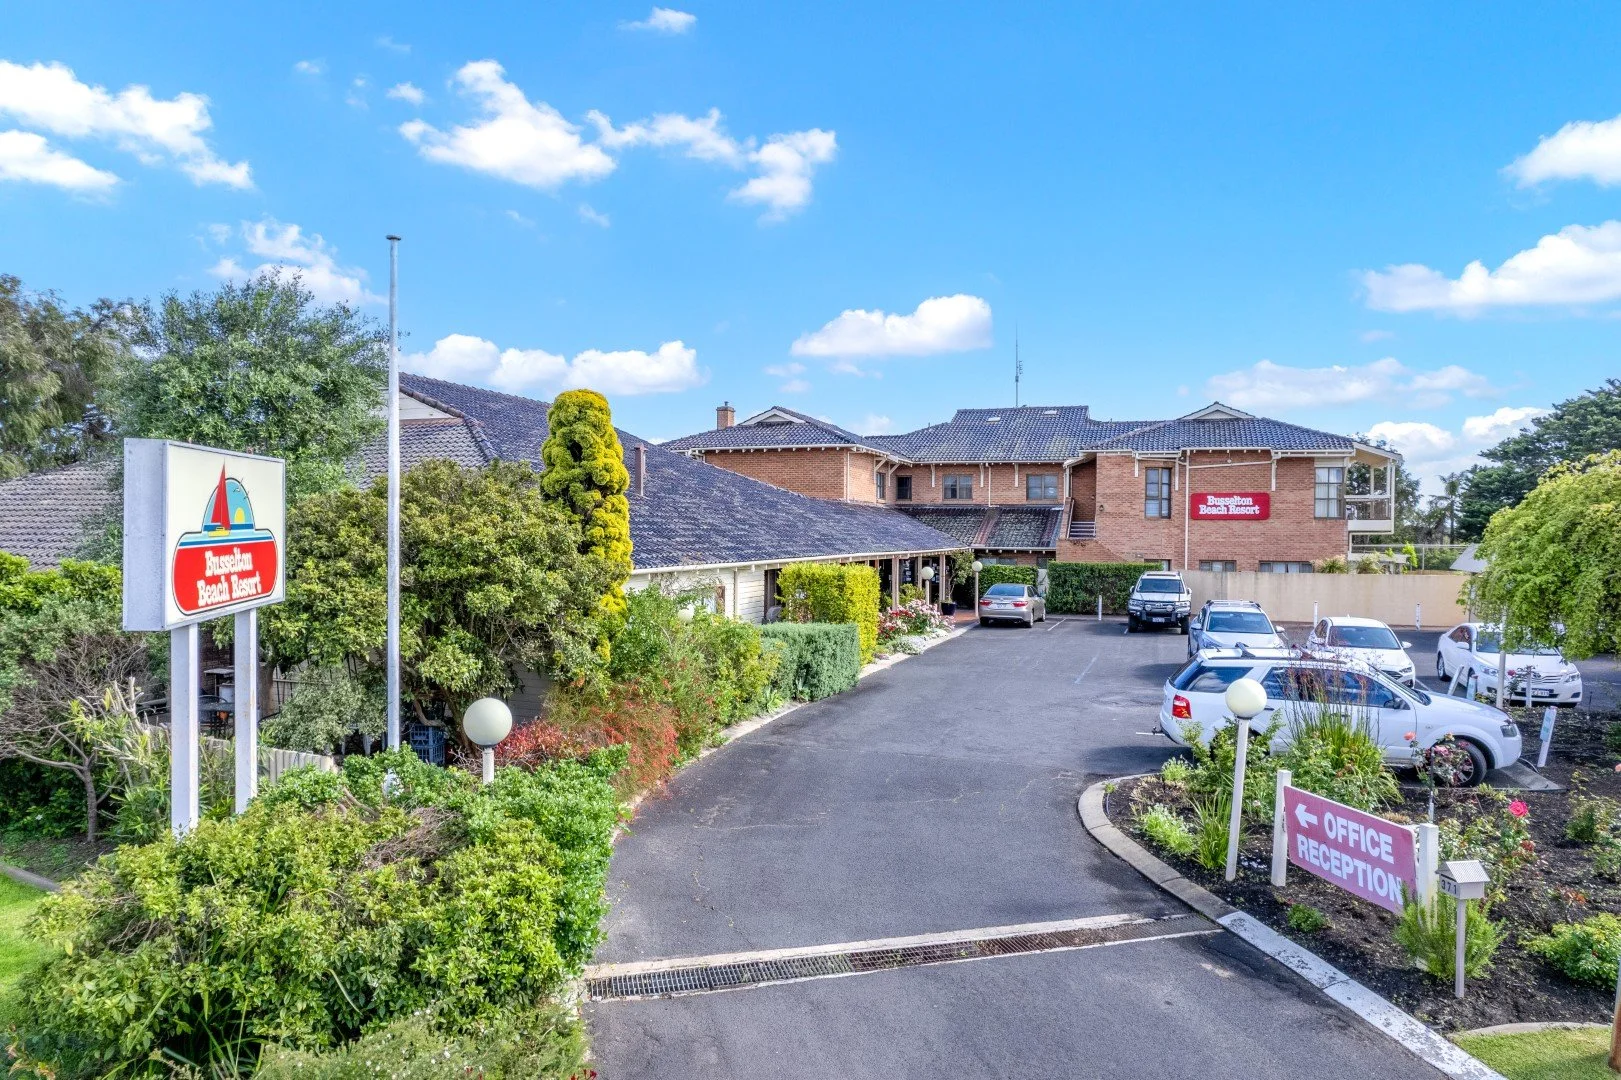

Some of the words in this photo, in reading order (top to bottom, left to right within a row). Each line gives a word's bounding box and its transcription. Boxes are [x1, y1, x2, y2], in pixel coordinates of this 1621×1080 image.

[1199, 505, 1227, 515] Beach
[1229, 505, 1260, 515] Resort
[1207, 495, 1253, 505] Busselton
[205, 547, 253, 577] Busselton
[197, 575, 231, 607] Beach
[231, 571, 262, 599] Resort
[1324, 812, 1394, 864] OFFICE
[1297, 833, 1403, 905] RECEPTION
[1441, 879, 1457, 895] 371
